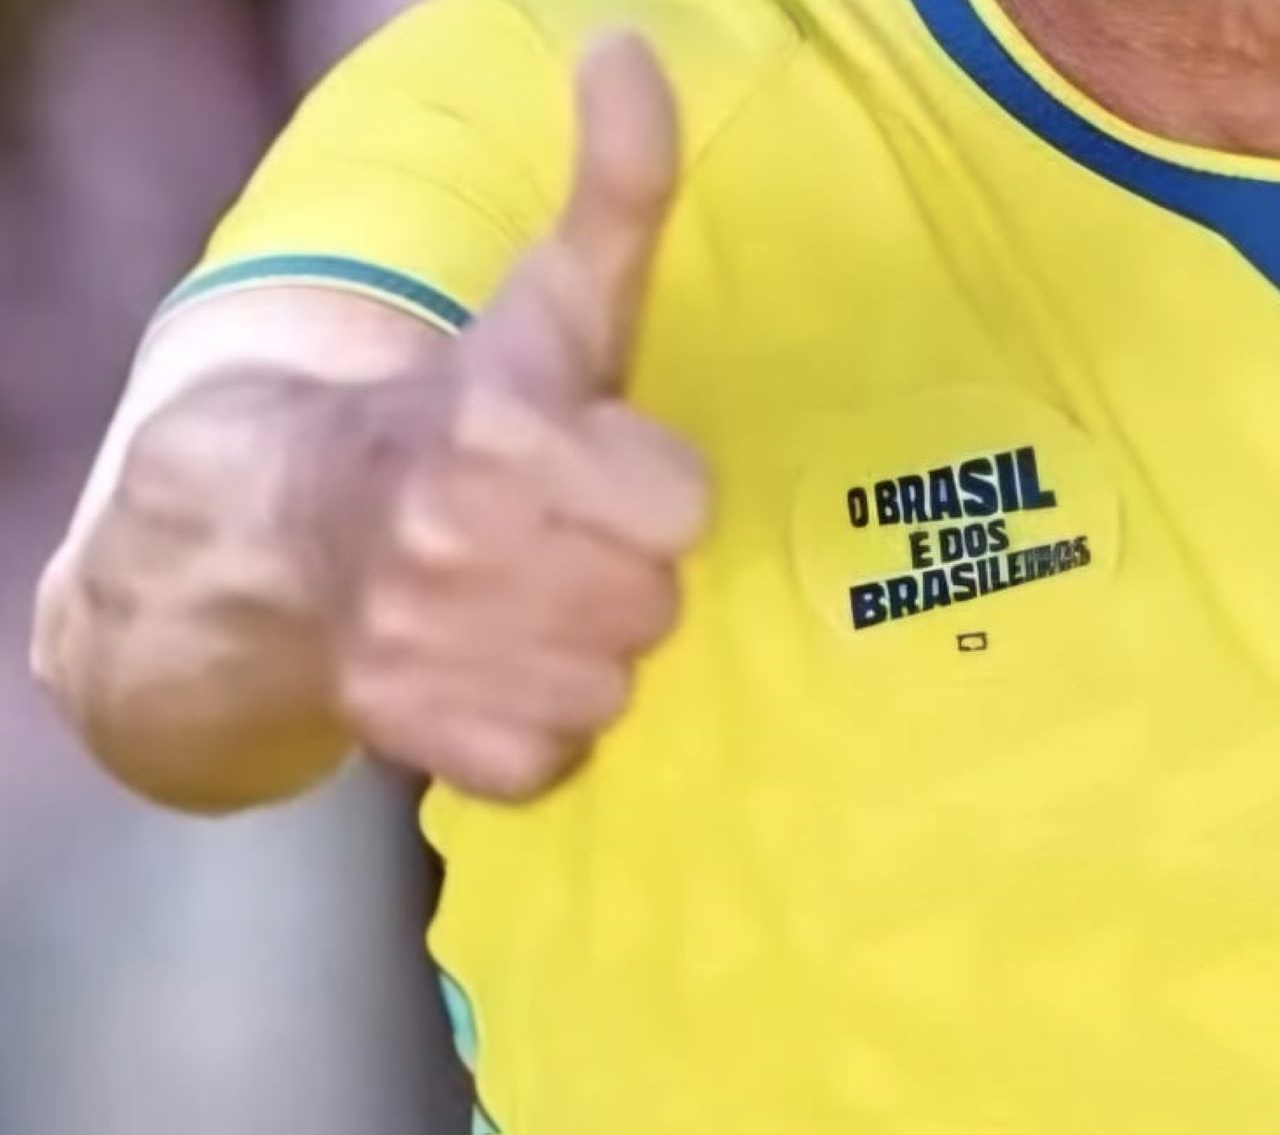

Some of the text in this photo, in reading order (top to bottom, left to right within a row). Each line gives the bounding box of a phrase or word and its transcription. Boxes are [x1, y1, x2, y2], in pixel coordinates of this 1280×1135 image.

[848, 446, 1057, 528] O BRASIL
[938, 519, 1009, 563] DOS
